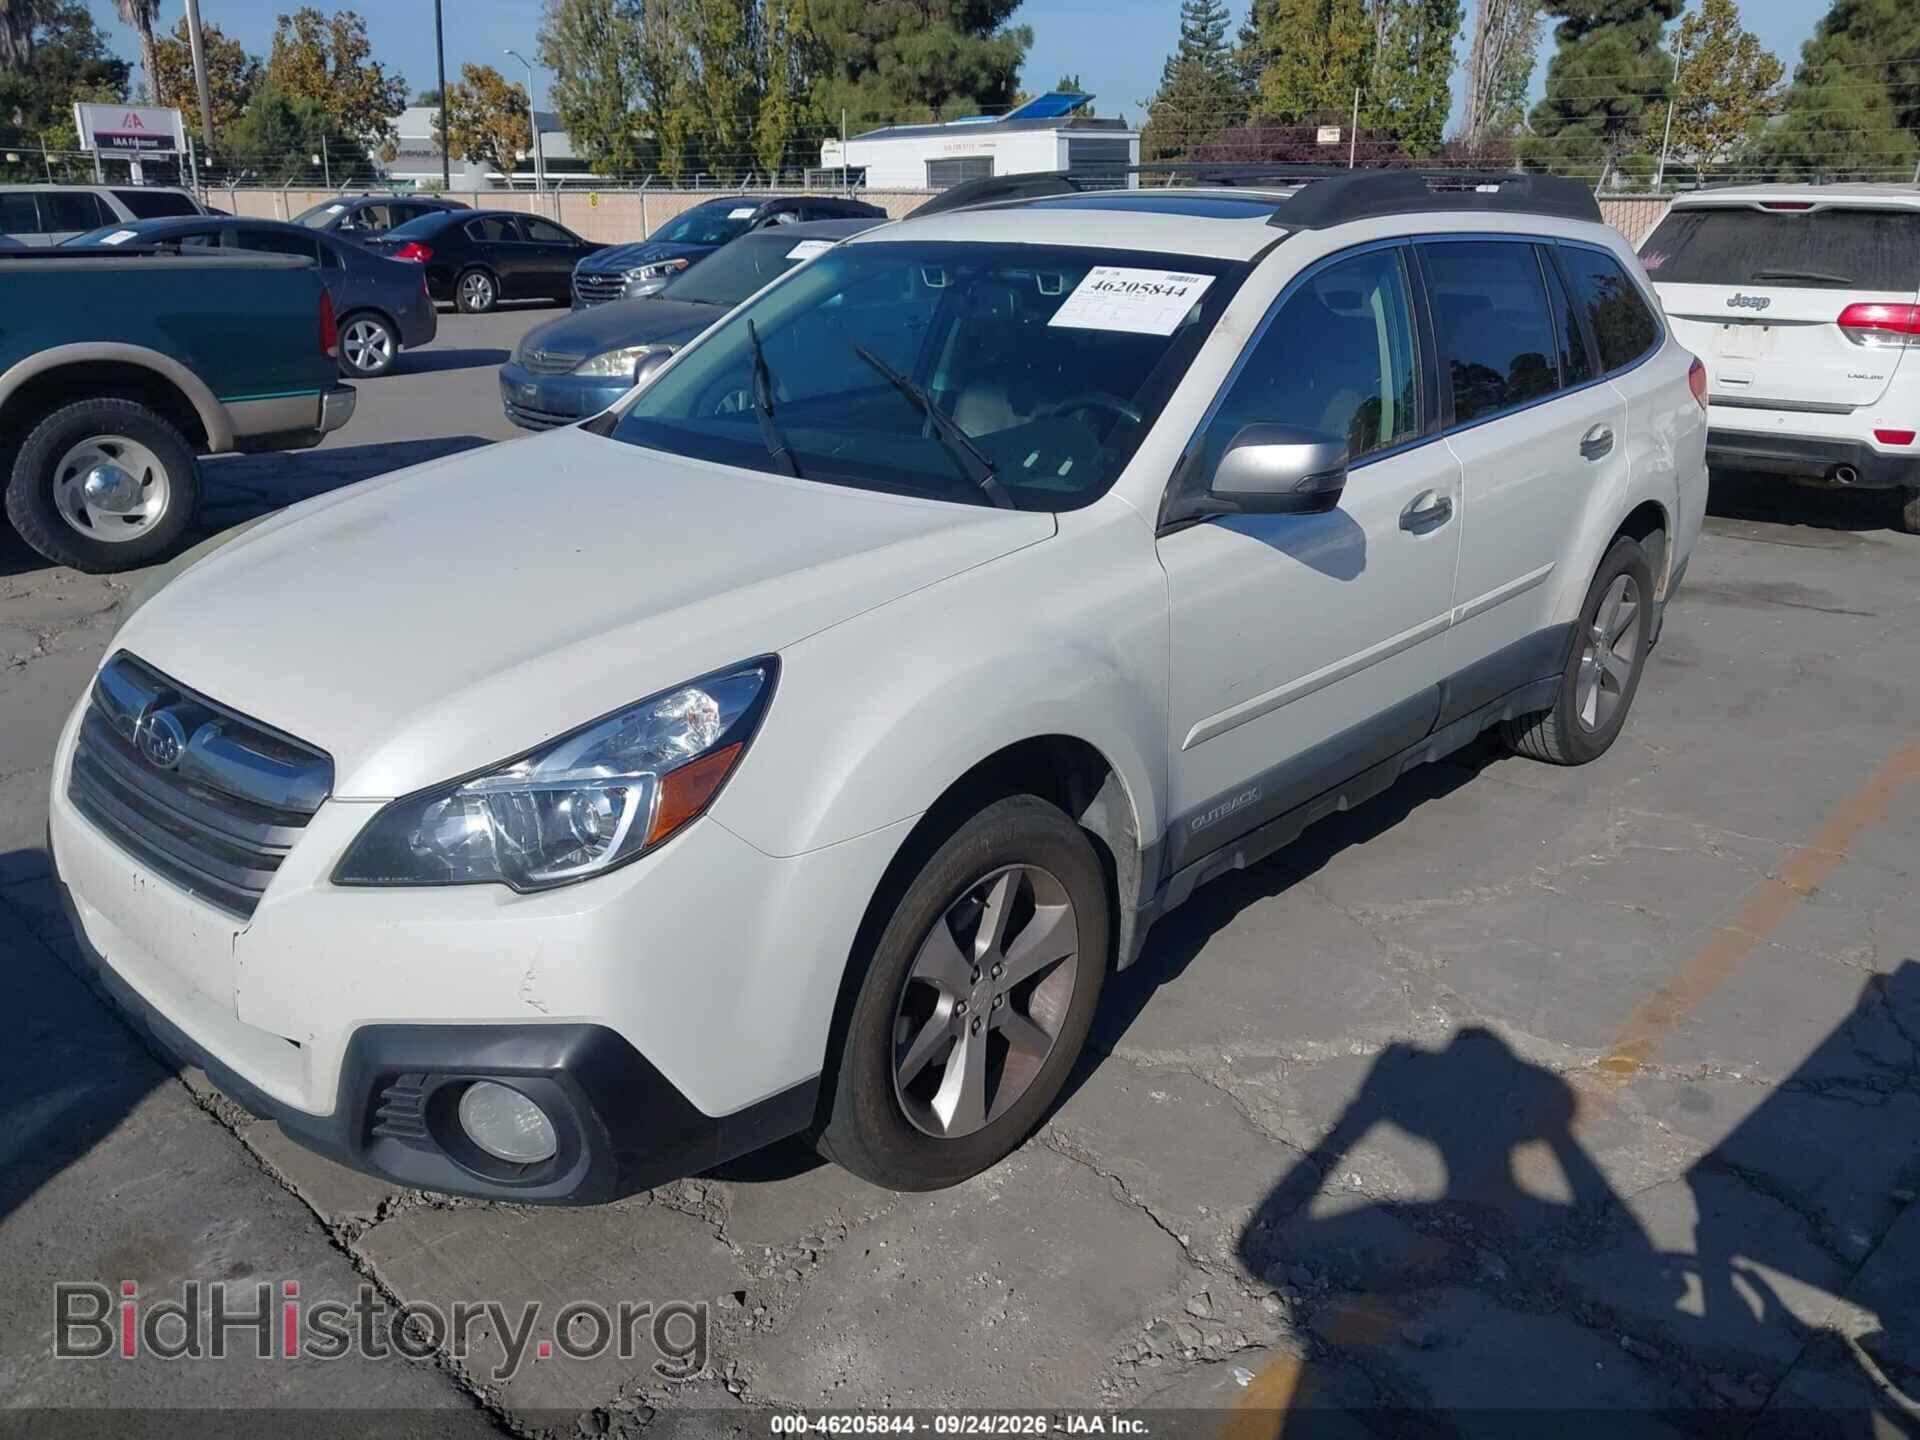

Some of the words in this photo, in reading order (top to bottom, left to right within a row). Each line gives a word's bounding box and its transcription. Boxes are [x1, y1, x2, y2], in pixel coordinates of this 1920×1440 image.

[1091, 279, 1188, 298] 46205844
[1727, 293, 1770, 311] Jeep
[1191, 787, 1257, 831] OUTBACK
